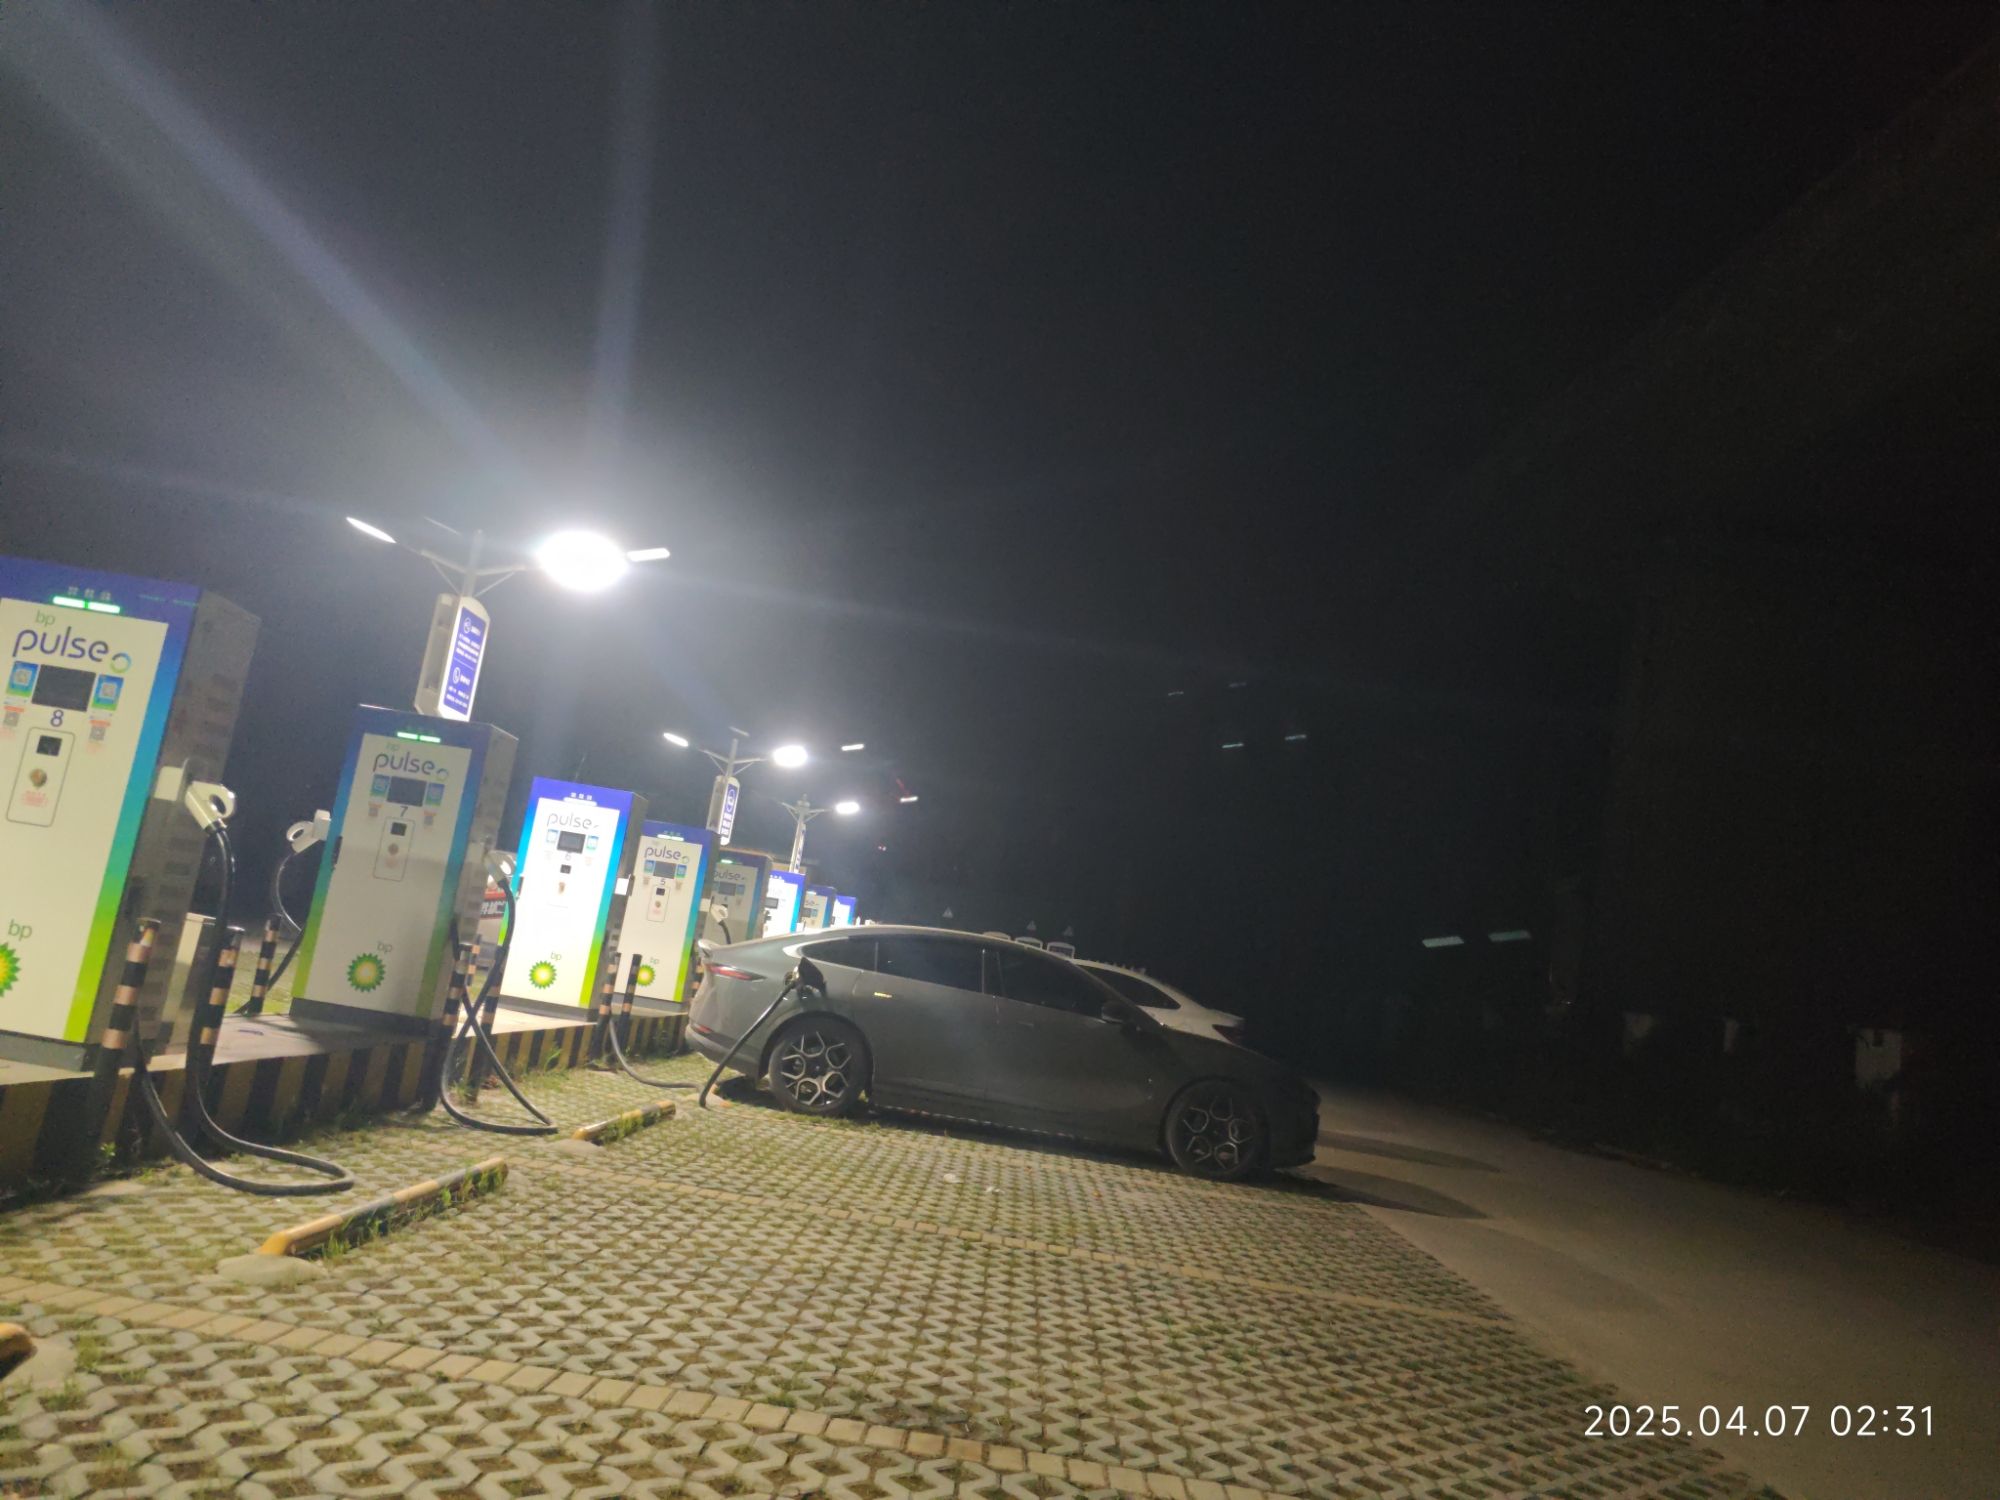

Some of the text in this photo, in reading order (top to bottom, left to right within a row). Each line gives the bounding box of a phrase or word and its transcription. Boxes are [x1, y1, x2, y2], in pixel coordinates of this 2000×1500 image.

[35, 610, 56, 626] bp
[12, 626, 109, 662] pulse
[50, 709, 64, 727] 8
[373, 751, 435, 775] pulse
[400, 805, 408, 817] 7
[547, 812, 592, 829] pulse
[644, 845, 681, 860] pulse
[8, 918, 33, 942] bp
